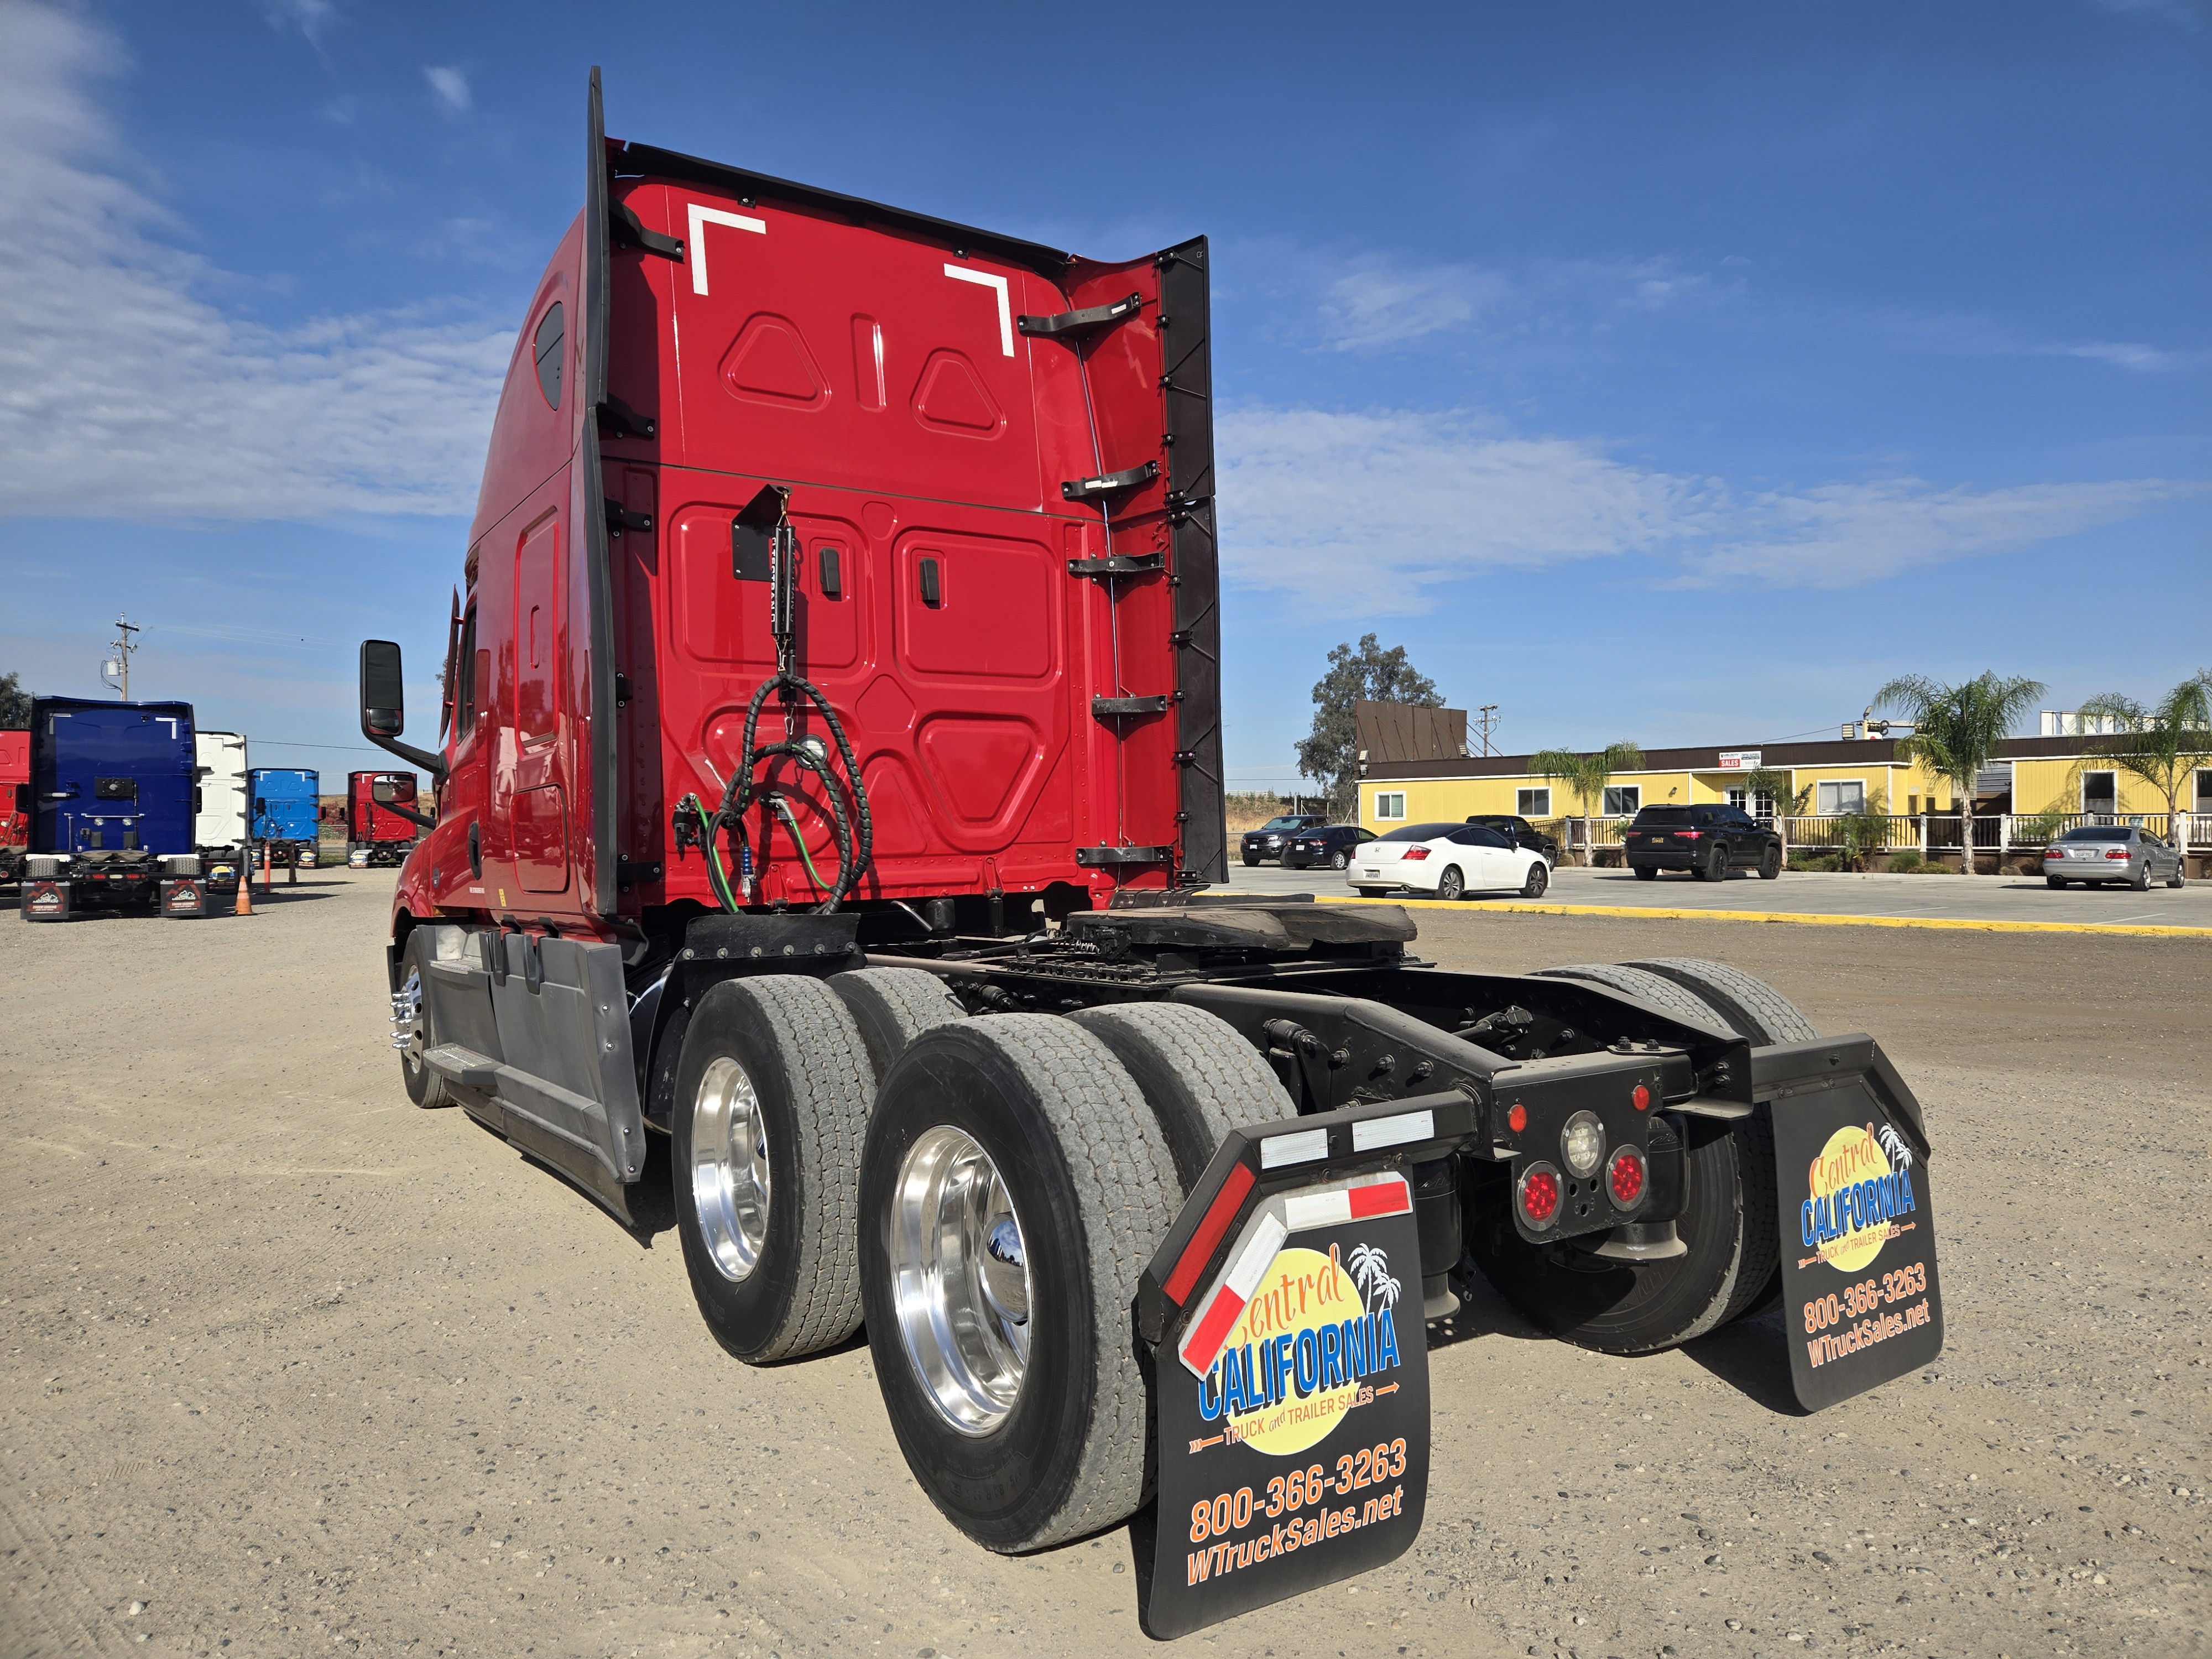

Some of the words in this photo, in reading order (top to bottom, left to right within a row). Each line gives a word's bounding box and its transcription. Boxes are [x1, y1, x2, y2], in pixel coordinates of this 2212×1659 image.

[1809, 1122, 1878, 1199] Central
[1801, 1170, 1916, 1247] CALIFORNIA
[1816, 1248, 1839, 1265] TRUCK
[1840, 1238, 1850, 1255] and
[1850, 1234, 1877, 1252] TRAILER
[1878, 1224, 1901, 1242] SALES
[1224, 1242, 1345, 1352] entral
[1804, 1262, 1927, 1334] 800-366-3263
[1807, 1297, 1931, 1368] WTruckSales.net
[1198, 1308, 1401, 1421] CALIFORNIA
[1224, 1417, 1265, 1446] TRUCK
[1269, 1406, 1286, 1432] and
[1287, 1397, 1335, 1426] TRAILER
[1338, 1386, 1374, 1409] SALES
[1190, 1437, 1407, 1543] 800-366-3263
[1186, 1485, 1404, 1587] WTruckSales.net
